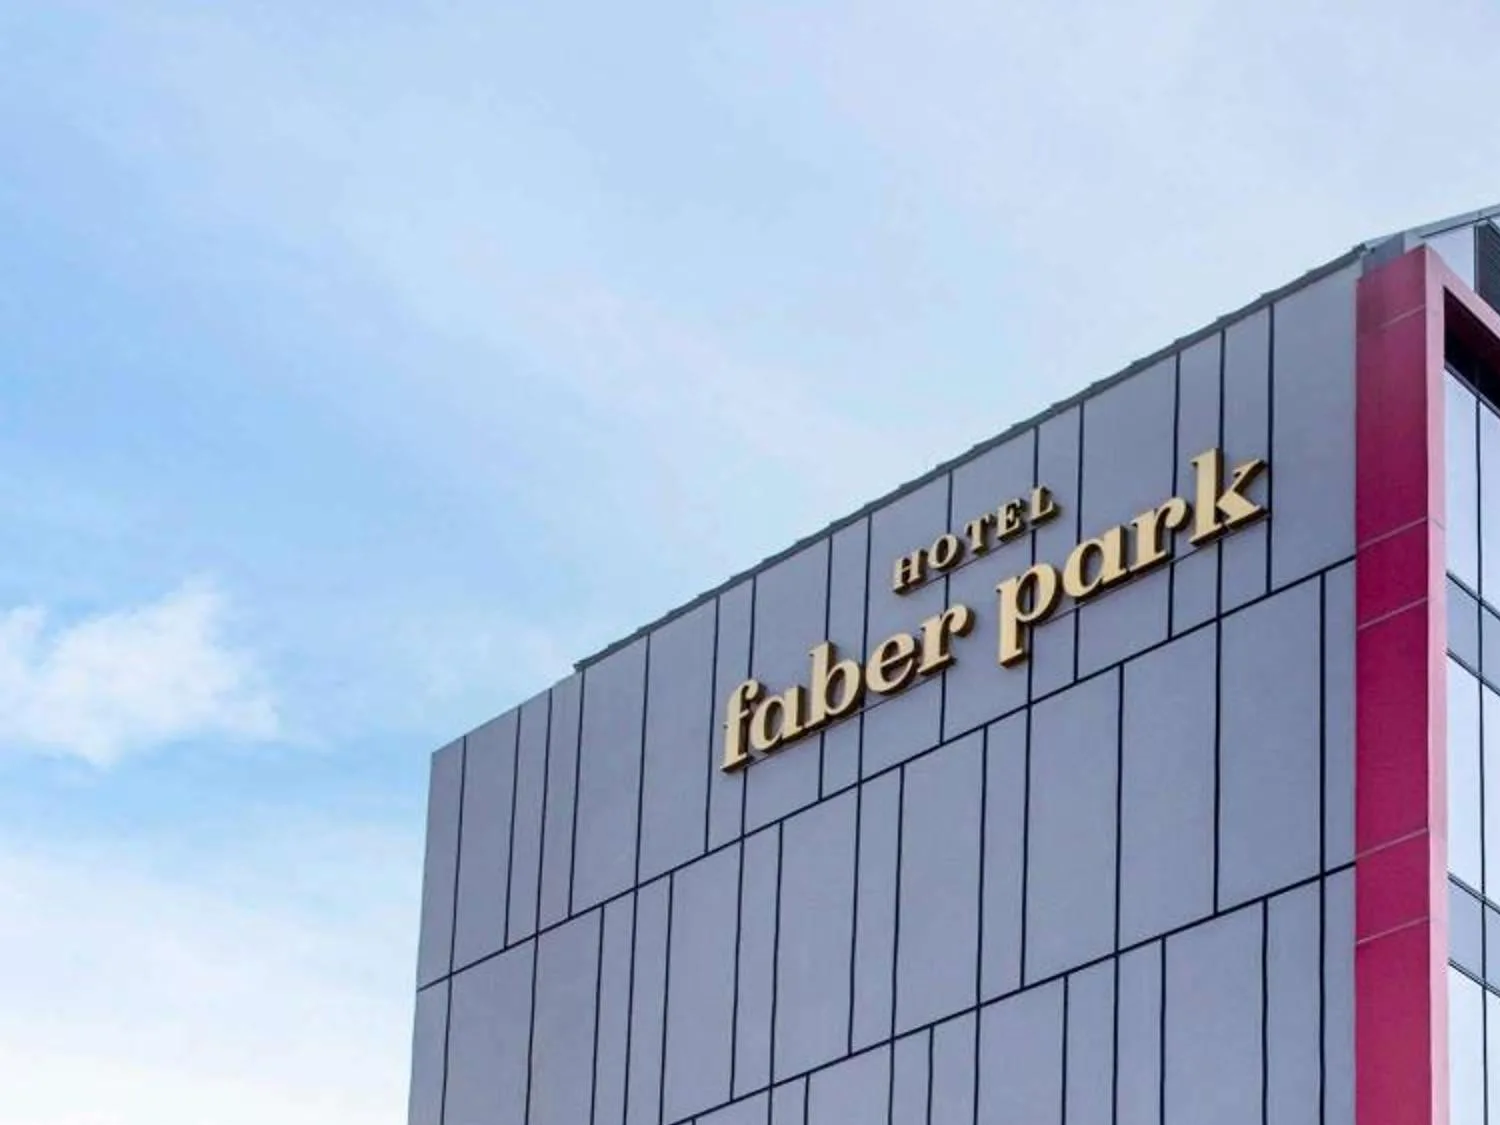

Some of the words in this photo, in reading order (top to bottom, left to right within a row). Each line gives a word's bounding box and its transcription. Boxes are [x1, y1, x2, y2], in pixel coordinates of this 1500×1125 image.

[720, 602, 974, 772] faber
[995, 447, 1270, 668] park
[891, 484, 1059, 593] HOTEL
